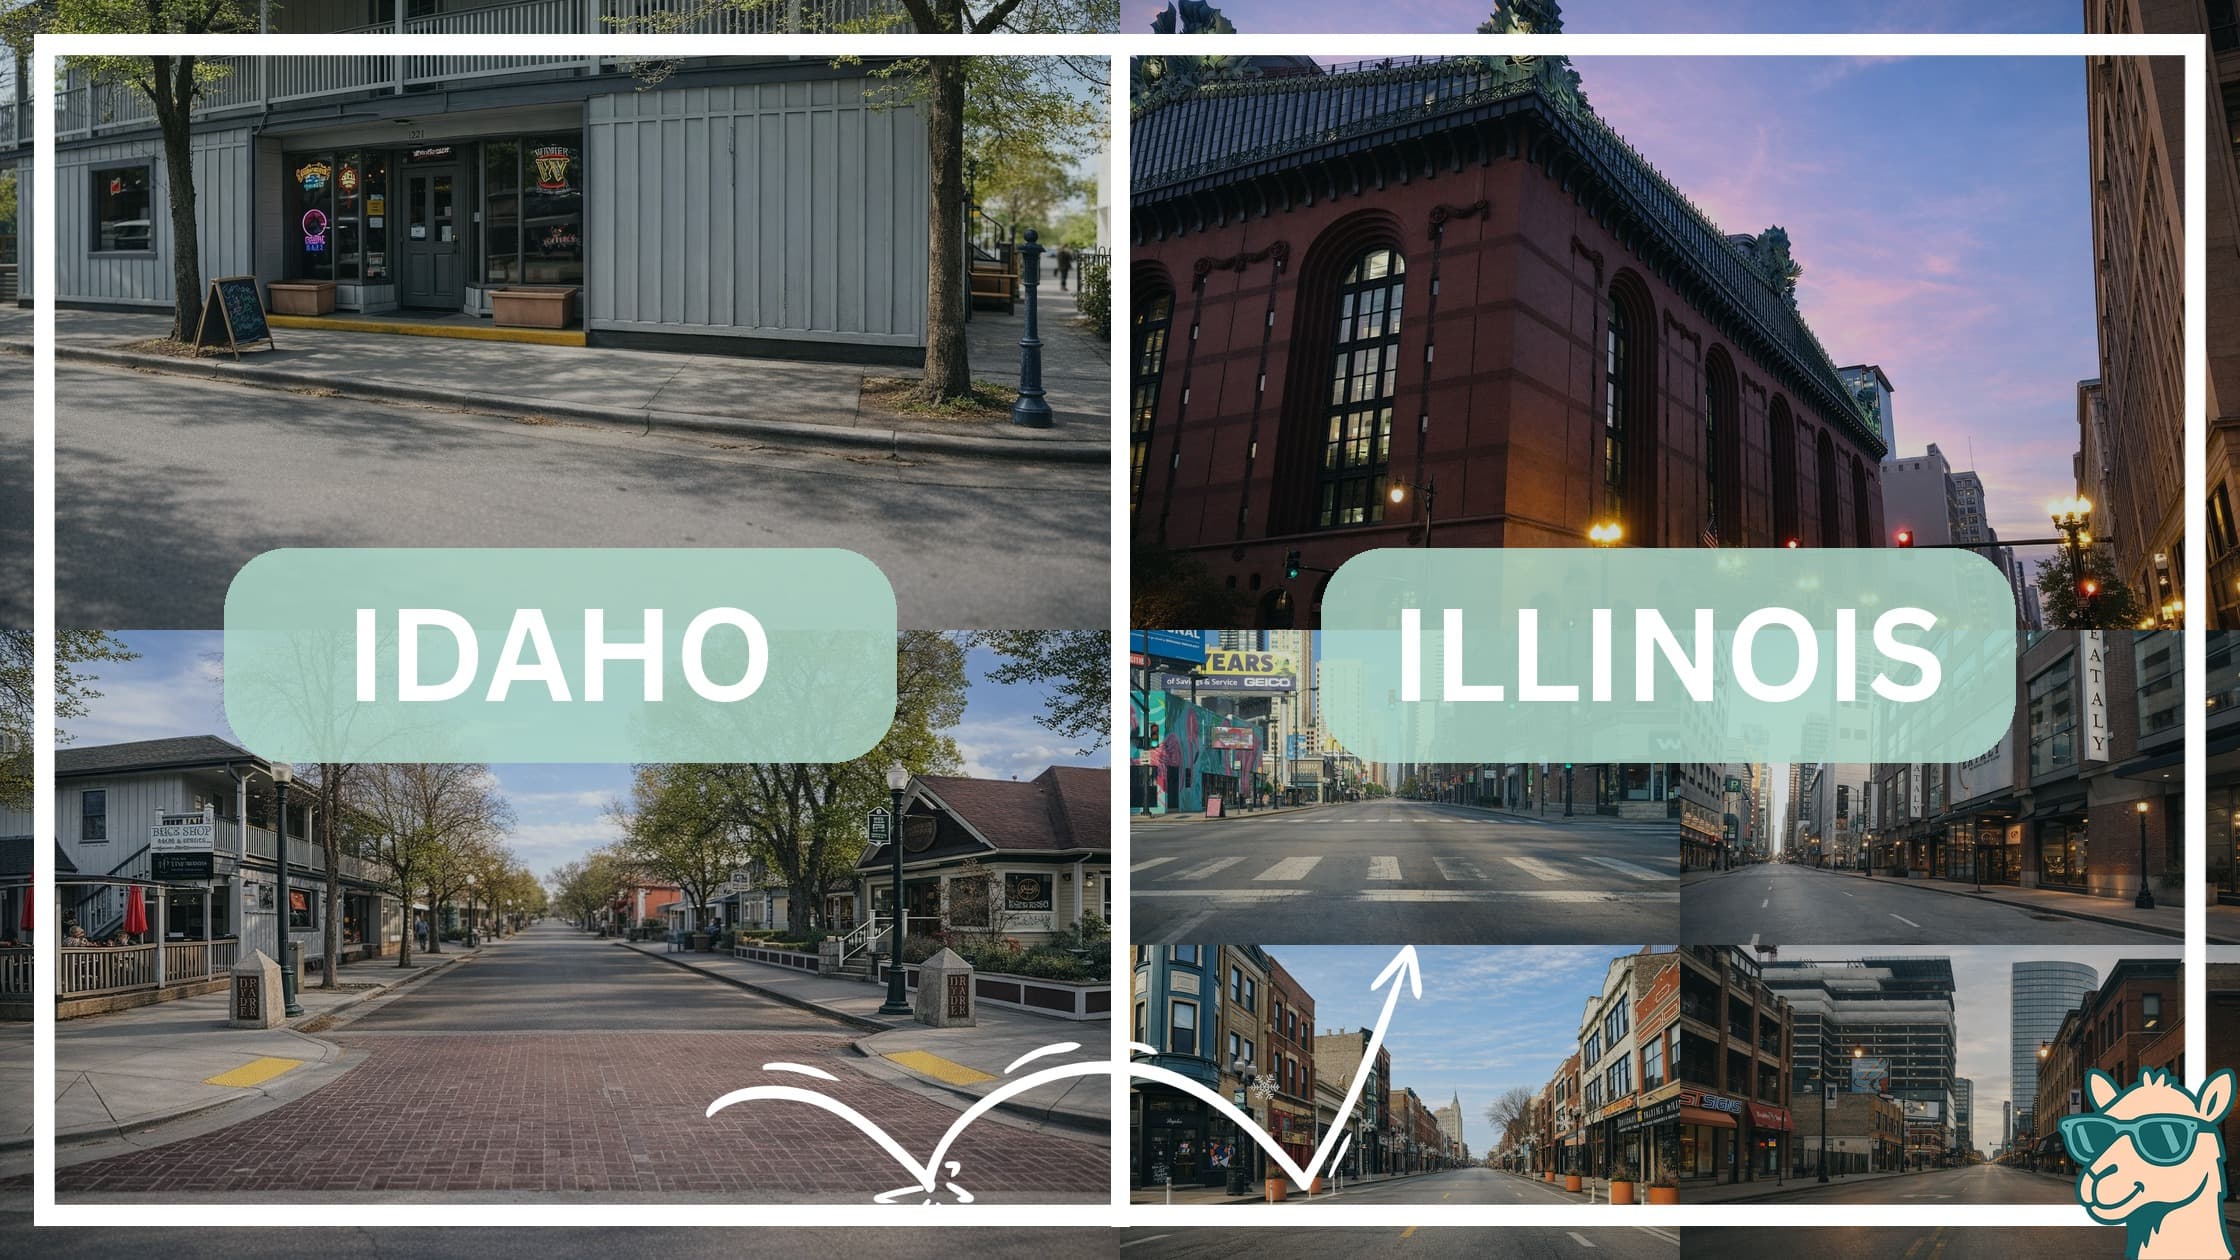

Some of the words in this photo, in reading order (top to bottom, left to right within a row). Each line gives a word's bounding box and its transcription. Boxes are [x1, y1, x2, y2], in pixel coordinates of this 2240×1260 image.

[1176, 679, 1204, 688] Savigs
[1211, 679, 1238, 687] Service
[1244, 677, 1291, 688] GEICO
[2089, 630, 2107, 751] EATALY
[1730, 780, 1739, 790] P
[182, 826, 212, 837] SHOP
